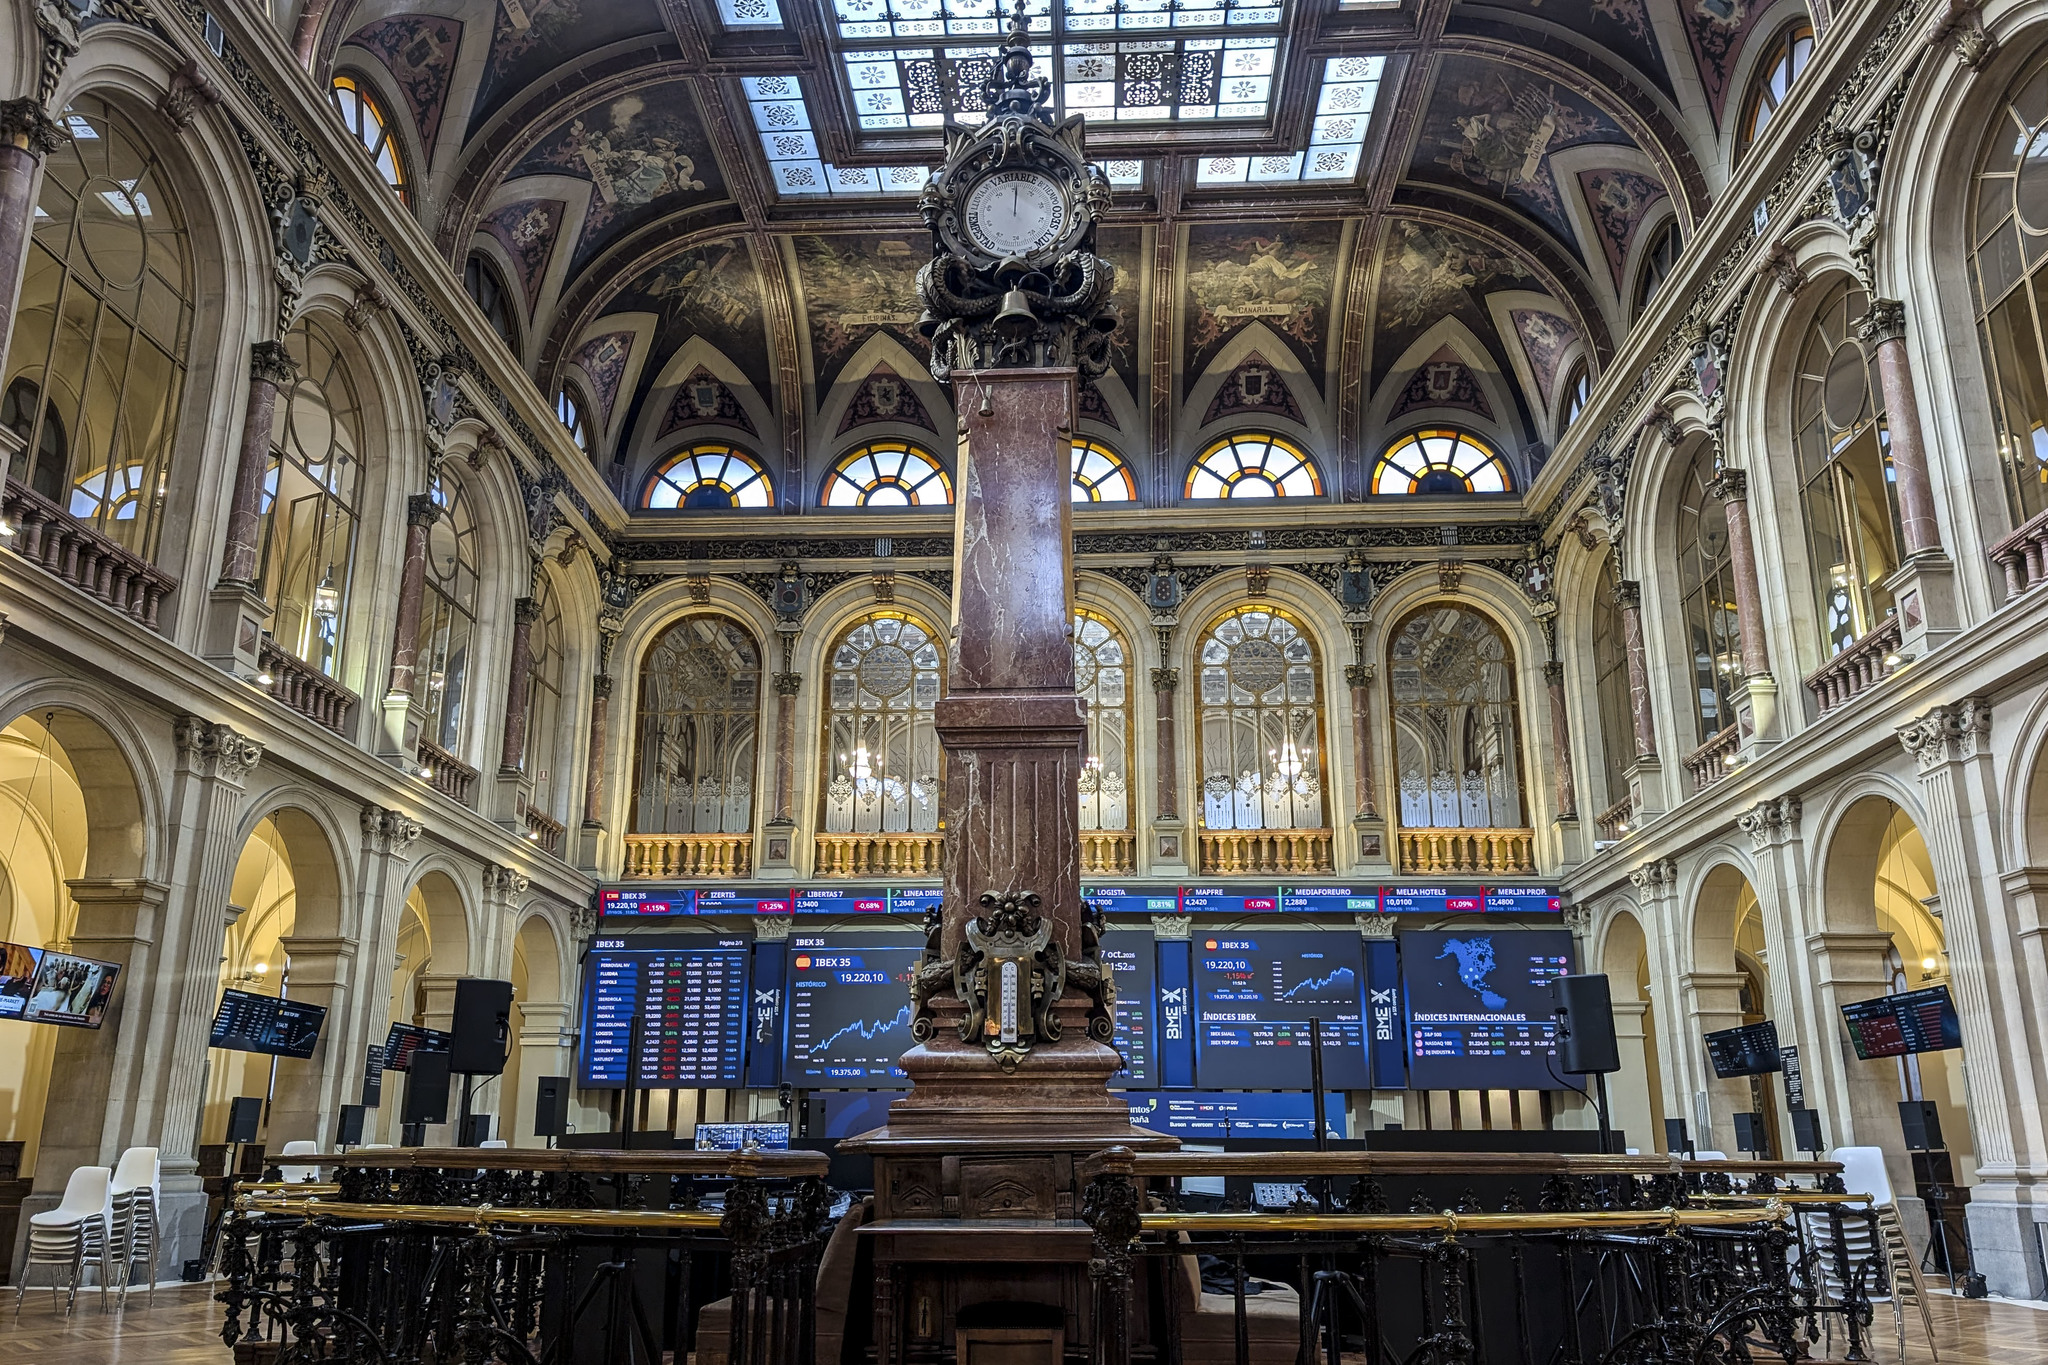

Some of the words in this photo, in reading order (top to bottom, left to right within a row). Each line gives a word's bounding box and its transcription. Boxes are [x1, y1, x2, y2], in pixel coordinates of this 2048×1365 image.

[990, 172, 1038, 187] VARIABLE
[969, 212, 996, 250] TEMPESTAD
[1034, 229, 1055, 249] MUY
[1050, 205, 1062, 230] SECO
[815, 959, 838, 967] IBEX
[839, 958, 851, 966] 35
[1206, 961, 1246, 970] 19.220,10
[841, 973, 883, 982] 19.220,10
[796, 980, 827, 988] HISTÓRICO
[1203, 1011, 1236, 1020] ÍNDICES
[1414, 1013, 1448, 1021] ÍNDICES
[1165, 1006, 1179, 1039] BME
[1375, 1007, 1390, 1040] BME
